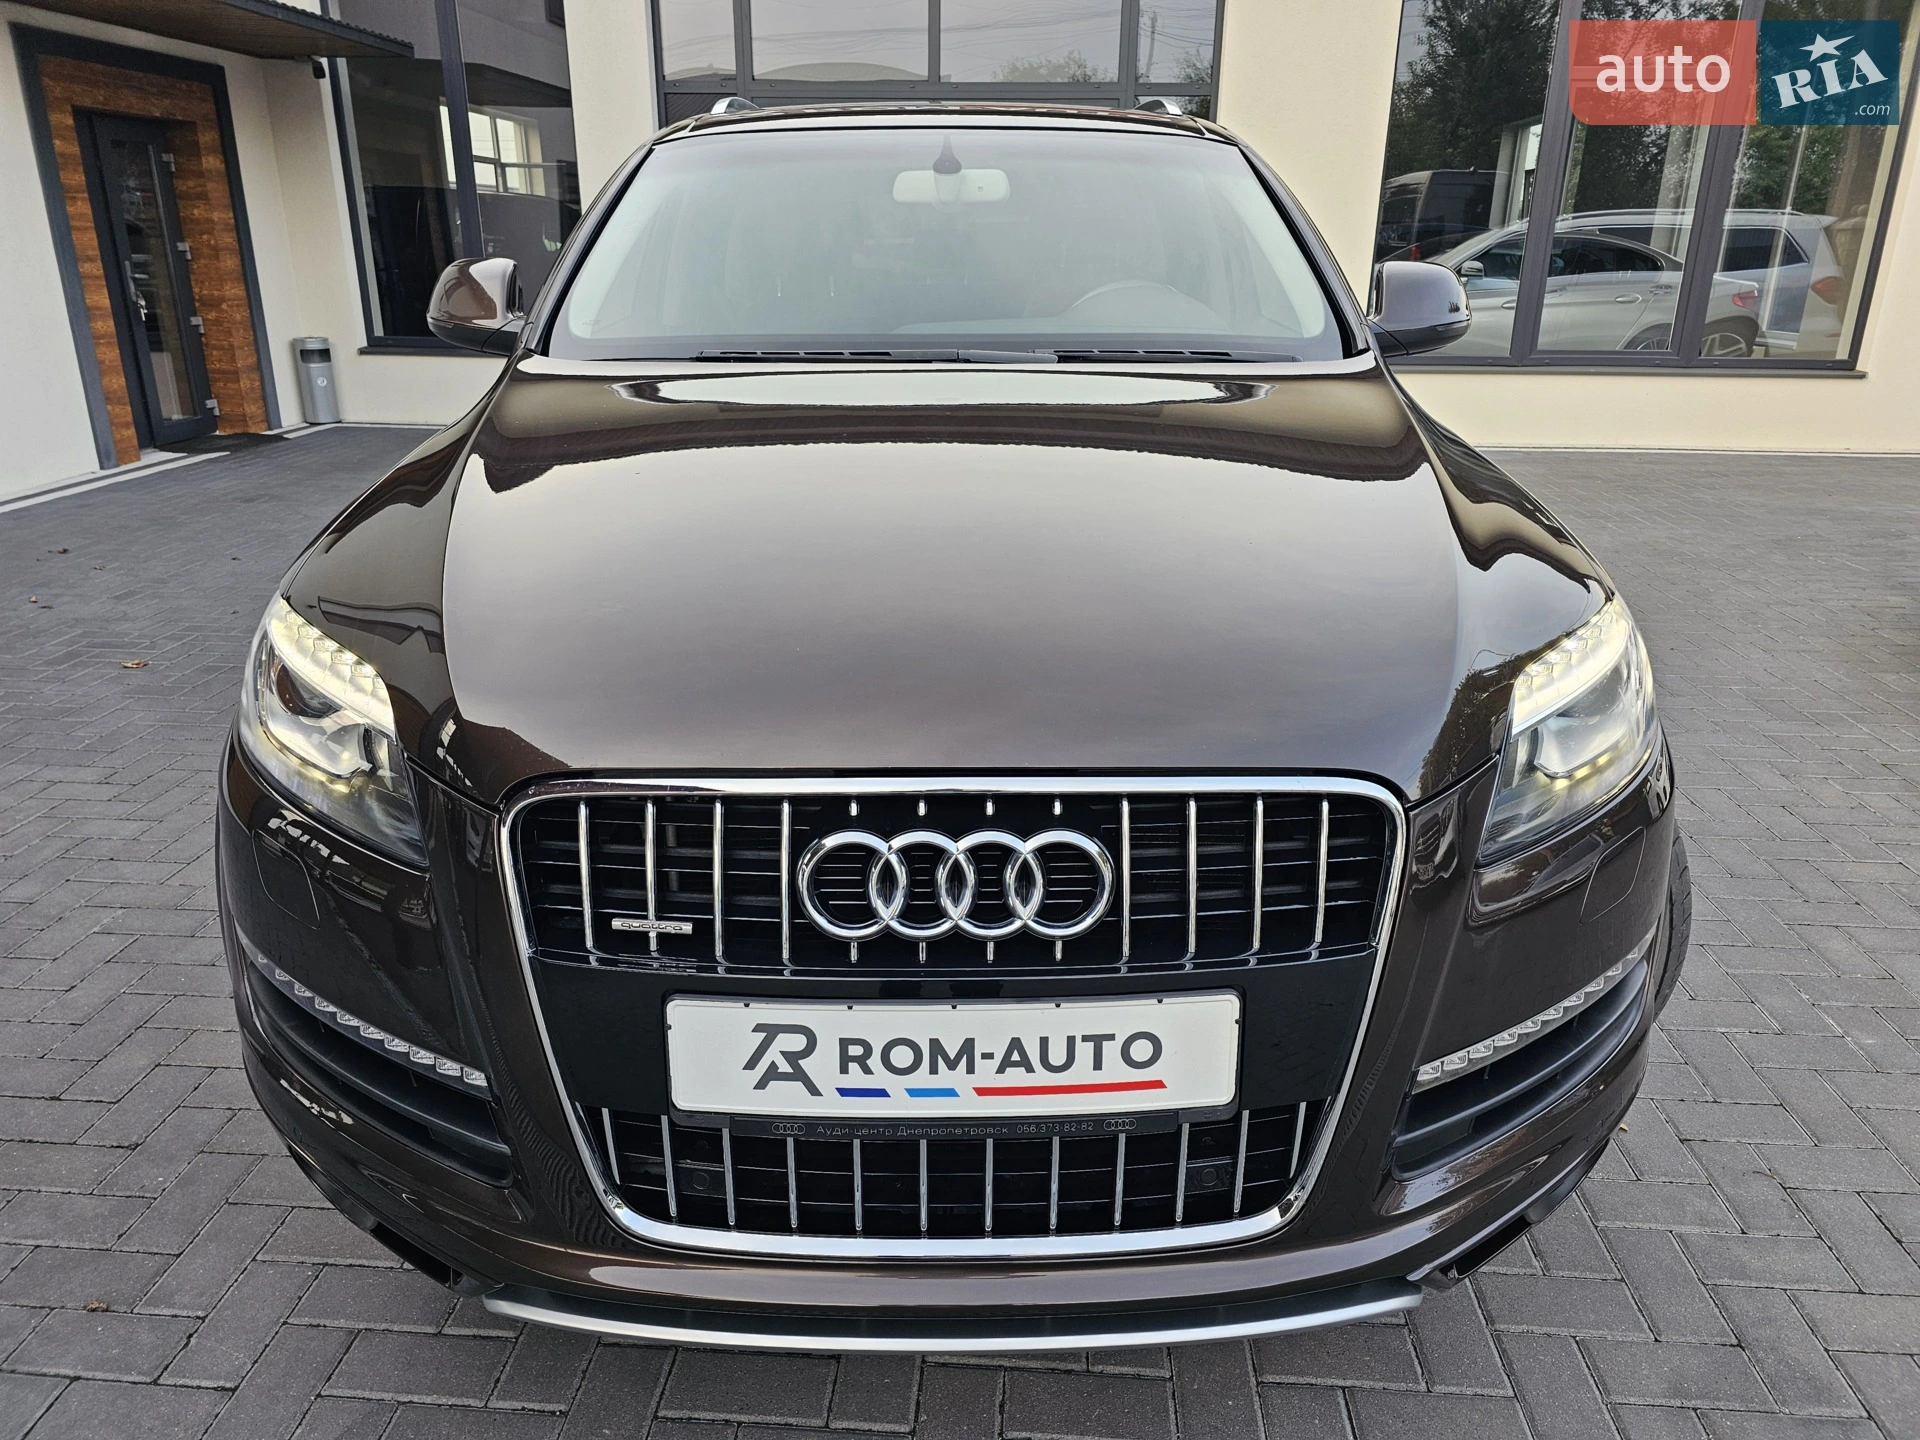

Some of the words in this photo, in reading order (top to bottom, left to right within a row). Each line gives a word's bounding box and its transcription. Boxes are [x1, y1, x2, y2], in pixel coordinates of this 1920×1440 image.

[620, 921, 683, 931] quattro
[838, 1030, 1163, 1077] ROM-AUTO
[897, 1126, 1009, 1136] Днепропетровск
[1016, 1121, 1094, 1134] 056/373-82-82
